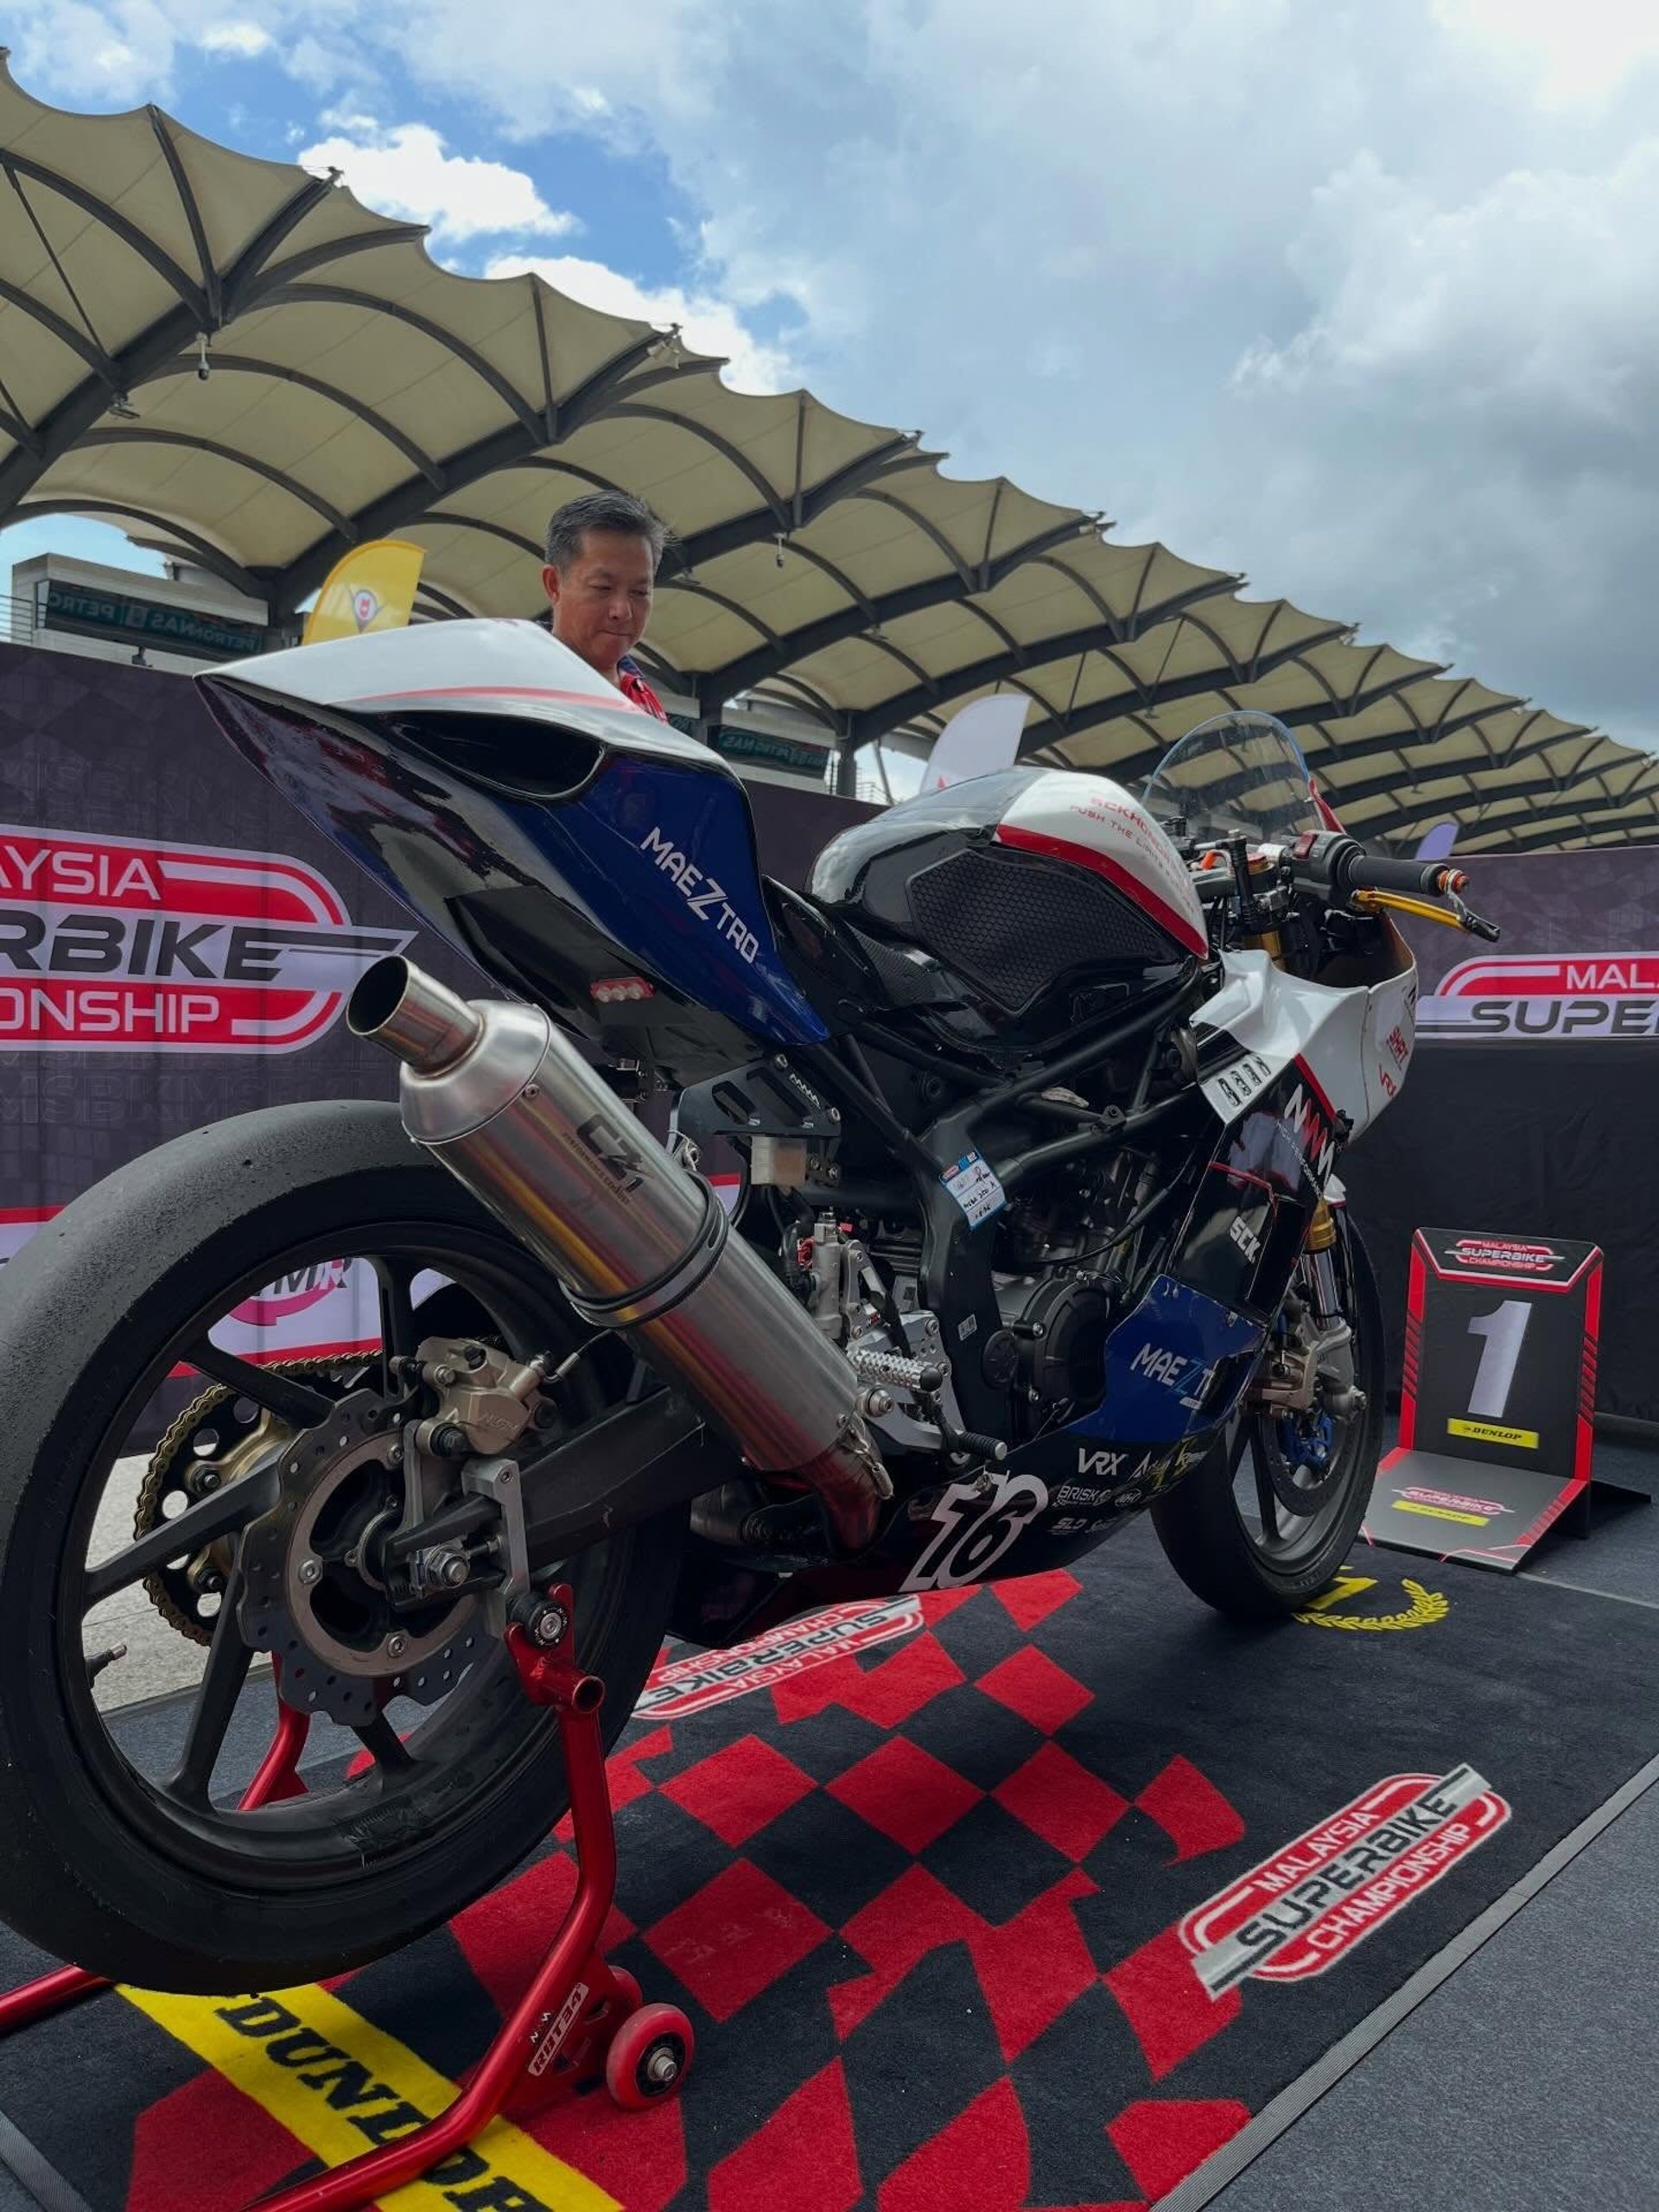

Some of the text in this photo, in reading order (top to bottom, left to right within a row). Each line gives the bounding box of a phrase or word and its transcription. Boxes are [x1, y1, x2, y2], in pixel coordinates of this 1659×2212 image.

[1110, 820, 1134, 838] THE
[0, 845, 162, 900] YSIA
[640, 827, 759, 964] MAEZTRO
[0, 909, 283, 982] RBIKE
[1567, 963, 1659, 990] MAL
[0, 988, 219, 1033] ONSHIP
[1471, 1000, 1659, 1034] SUPE
[1461, 1247, 1545, 1263] SUPERBIKE
[1468, 1256, 1536, 1269] CHAMPIONSHIP
[1481, 1242, 1529, 1252] MALAYSIA
[1129, 1342, 1216, 1396] MAEZT
[1467, 1300, 1533, 1418] 1
[1471, 1426, 1523, 1441] DUNLOP
[1077, 1447, 1128, 1477] VRX
[654, 1612, 888, 1700] SUPERBIKE
[734, 1638, 861, 1689] MALAYSIA
[1236, 1796, 1459, 1953] SUPERBIKE
[1255, 1809, 1381, 1893] MALAYSIA
[1306, 1821, 1471, 1951] CHAMPIONSHIP
